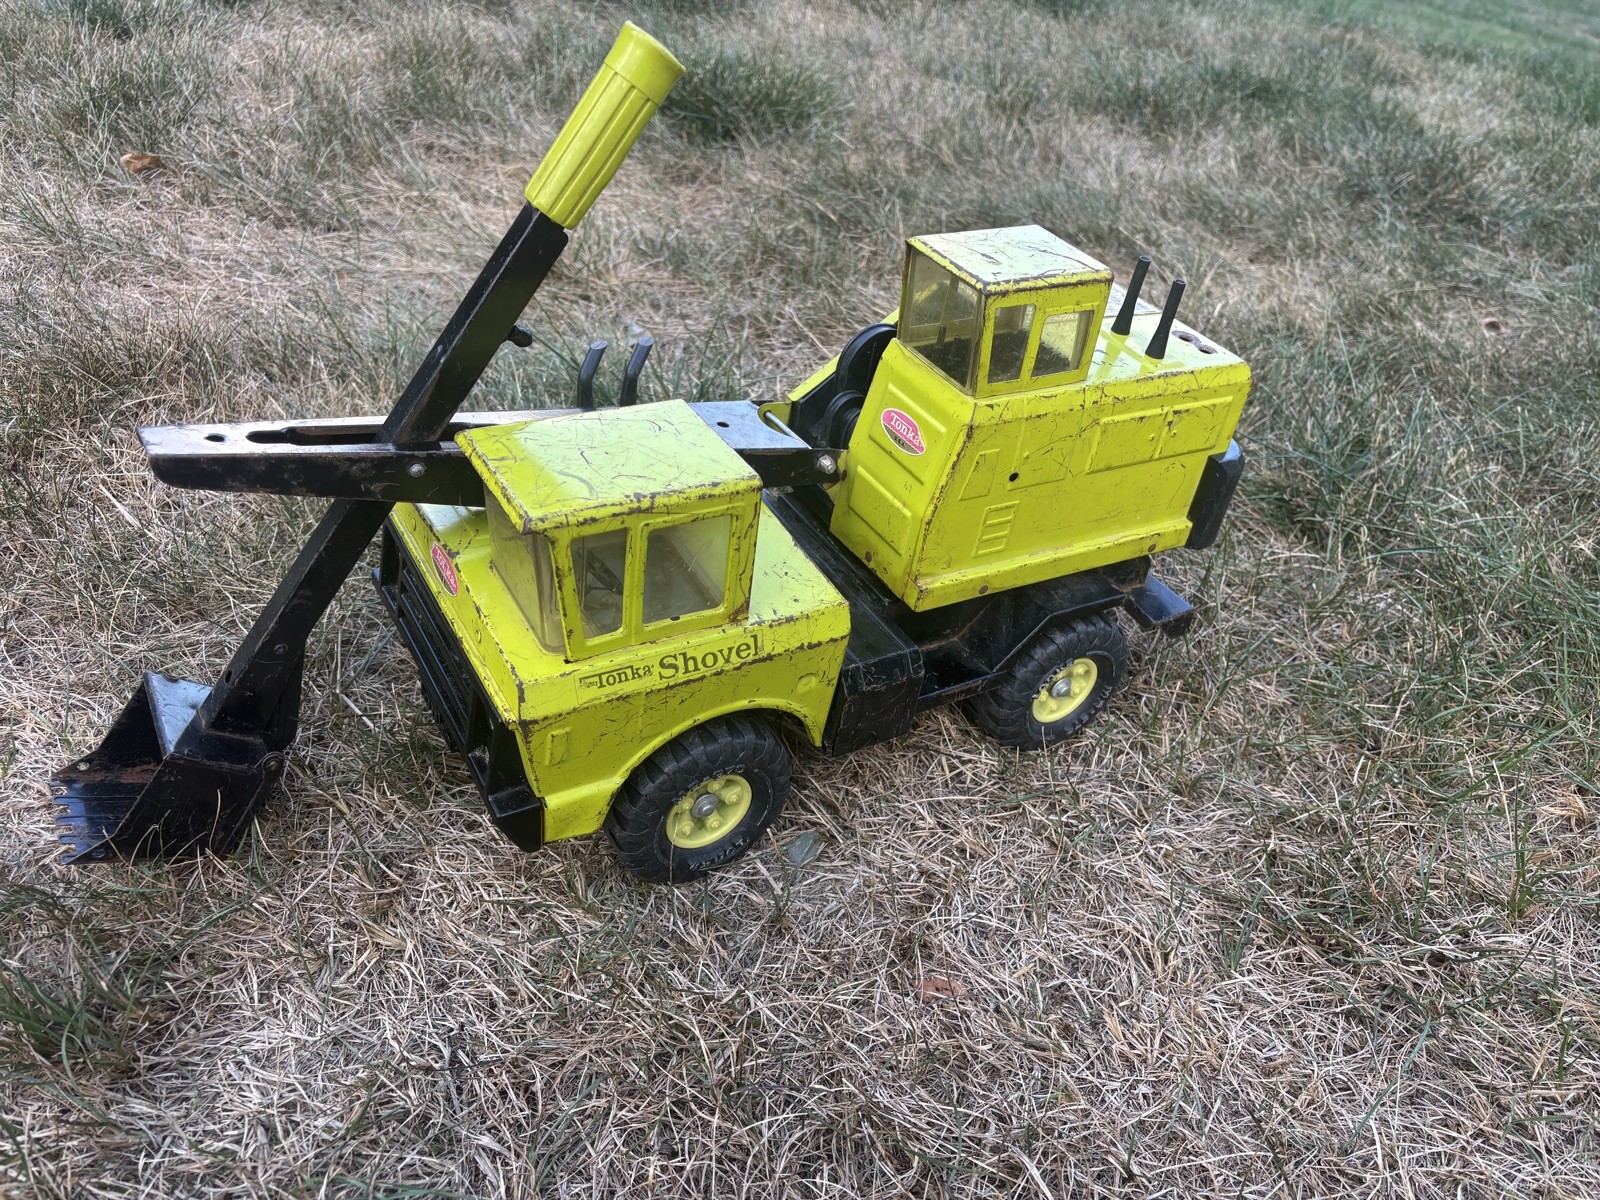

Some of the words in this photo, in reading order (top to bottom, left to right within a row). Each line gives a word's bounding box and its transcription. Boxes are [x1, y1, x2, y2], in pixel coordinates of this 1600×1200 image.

[890, 411, 920, 446] Tonka
[435, 545, 456, 587] Tonka
[579, 664, 652, 689] Tonka
[658, 634, 759, 681] Shovel
